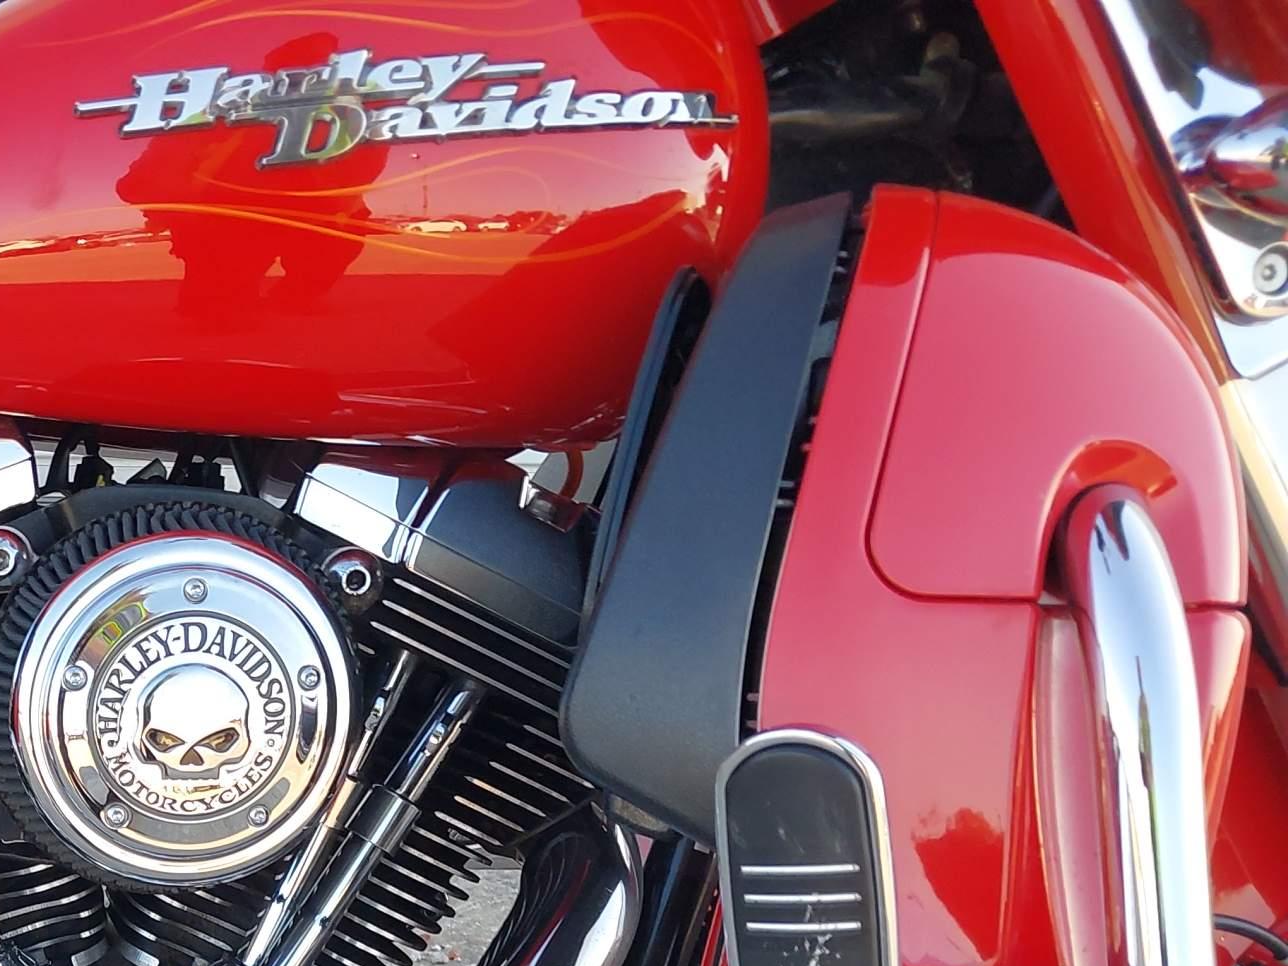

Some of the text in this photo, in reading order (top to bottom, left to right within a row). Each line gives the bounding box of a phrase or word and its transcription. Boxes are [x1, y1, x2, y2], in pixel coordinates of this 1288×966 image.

[74, 48, 545, 136] Harley
[230, 78, 740, 170] Davidson
[98, 622, 286, 737] HARLEY-DAVIDSON
[106, 751, 273, 813] MOTORCYCLES
